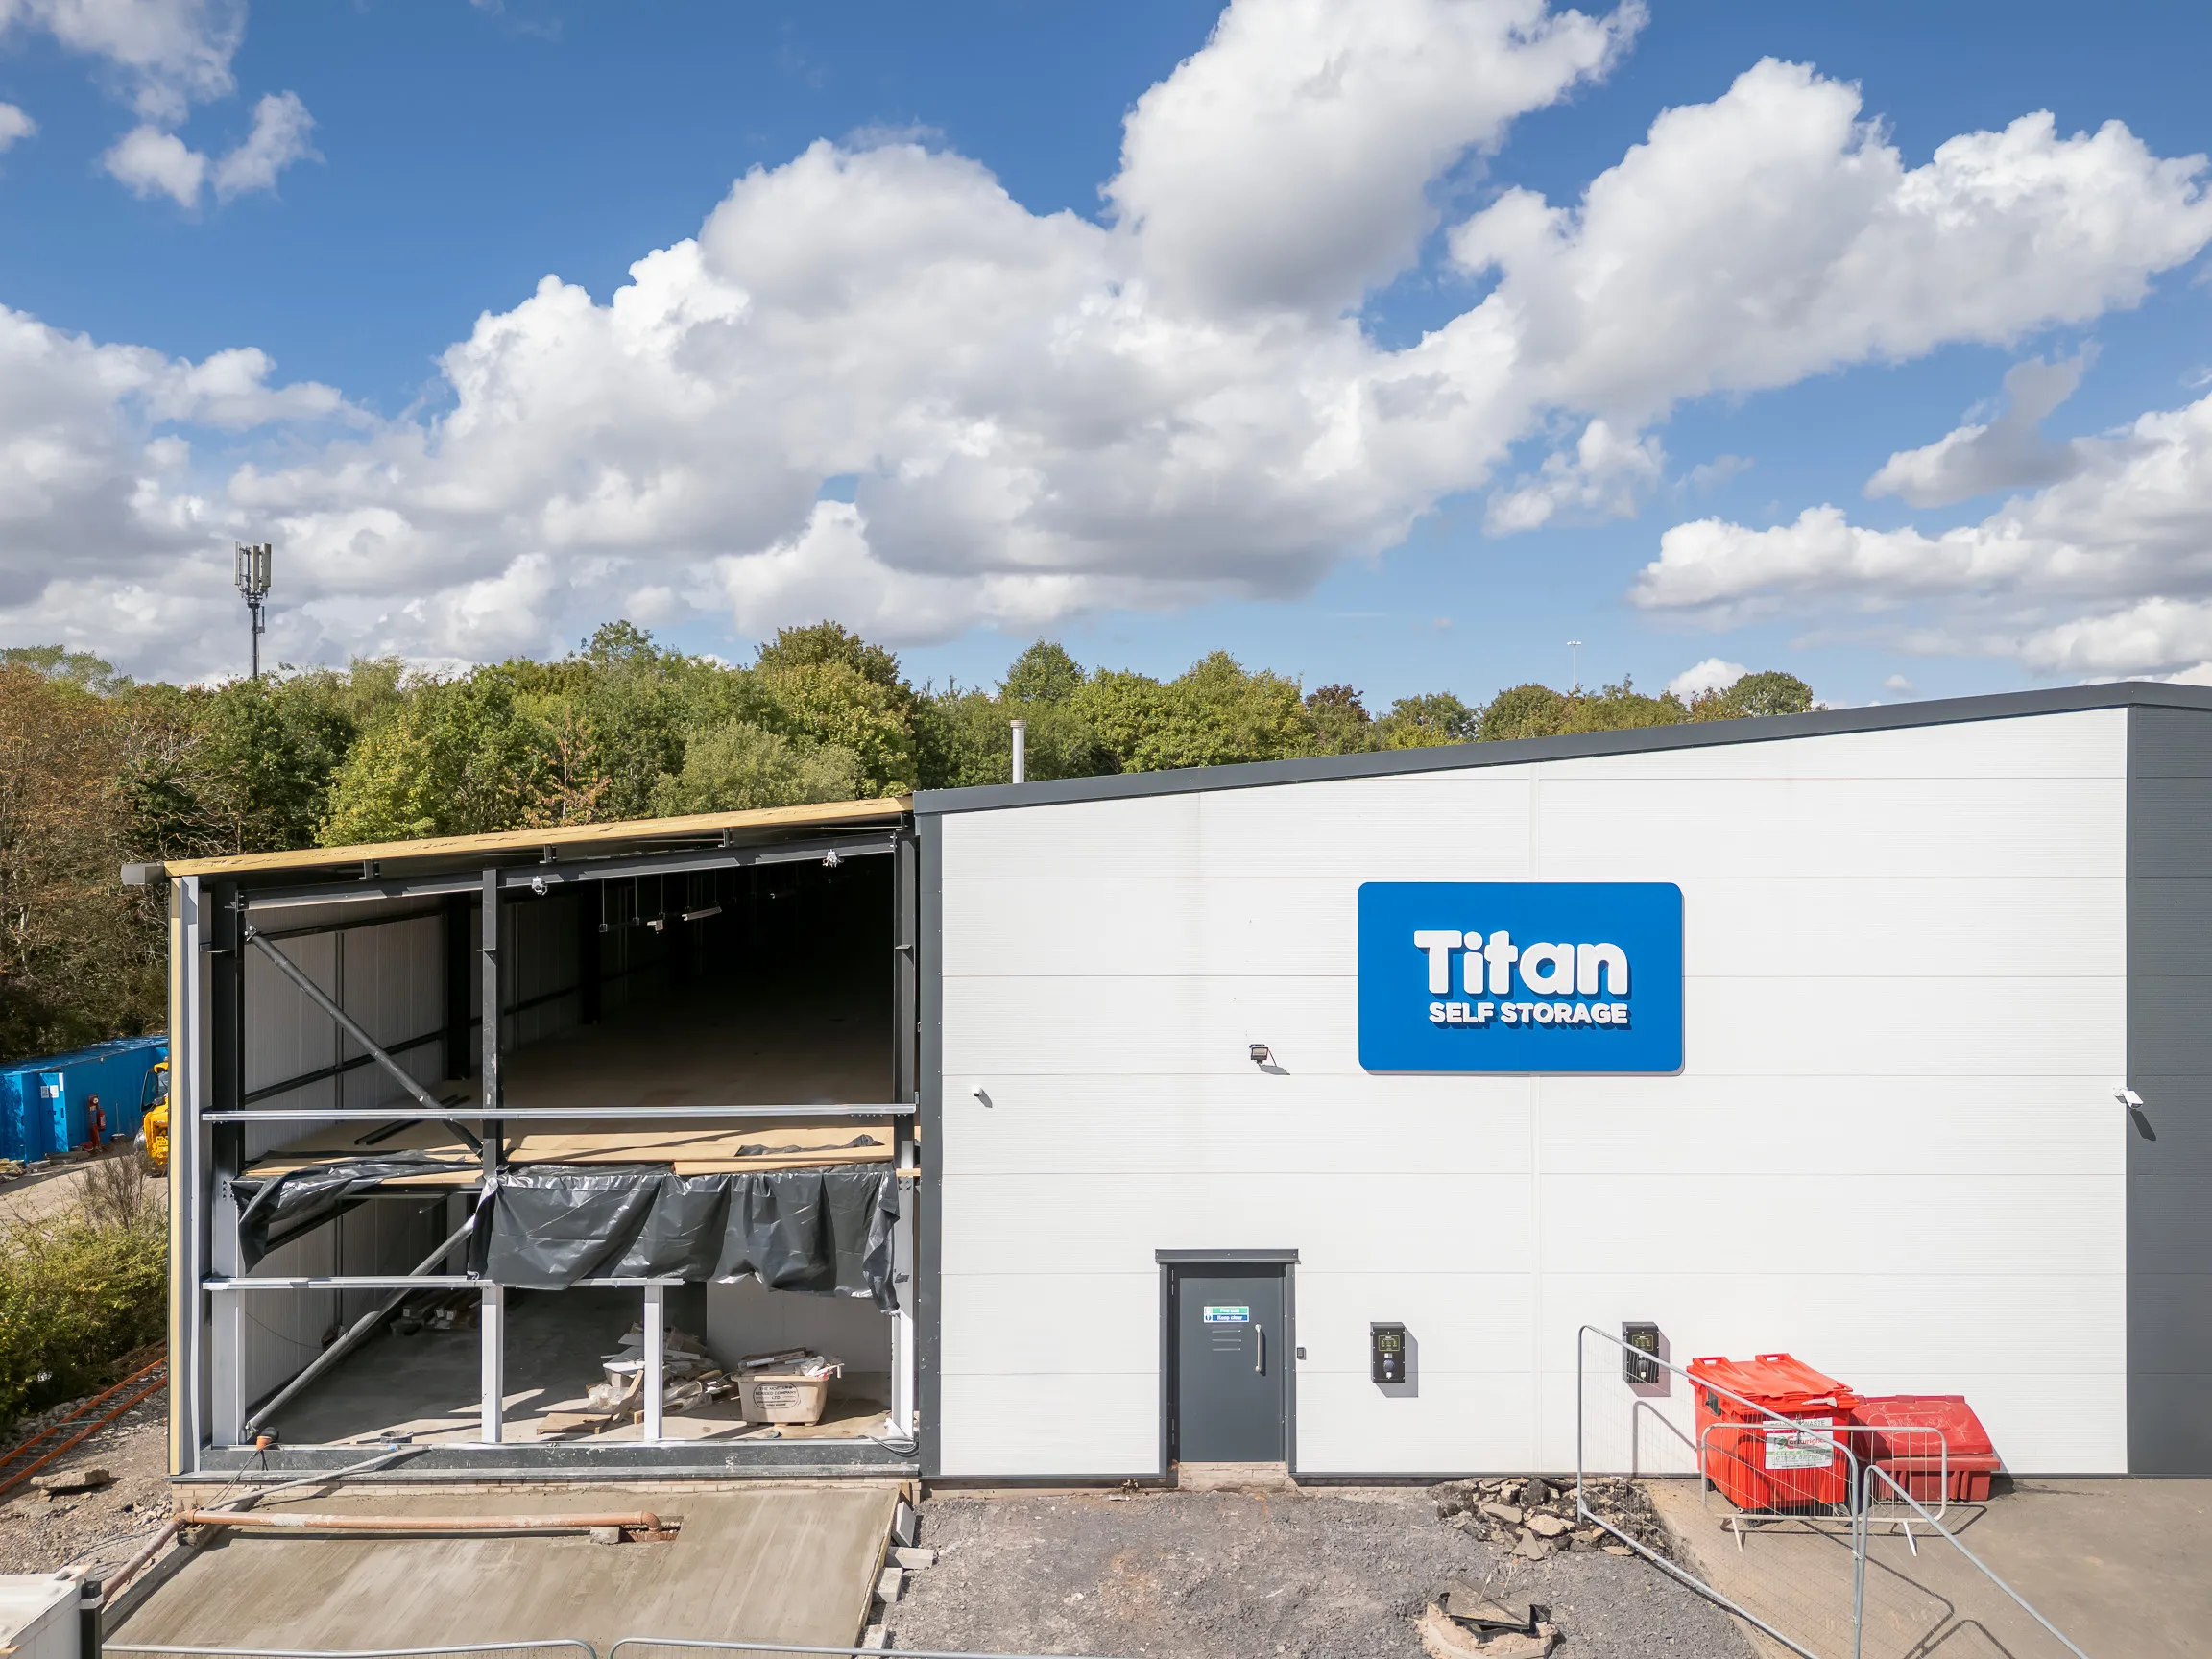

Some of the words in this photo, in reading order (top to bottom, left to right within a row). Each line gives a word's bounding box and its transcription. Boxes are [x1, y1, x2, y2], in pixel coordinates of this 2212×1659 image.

[1413, 929, 1629, 995] Titan
[1429, 1002, 1495, 1024] SELF
[1500, 1002, 1628, 1025] STORAGE
